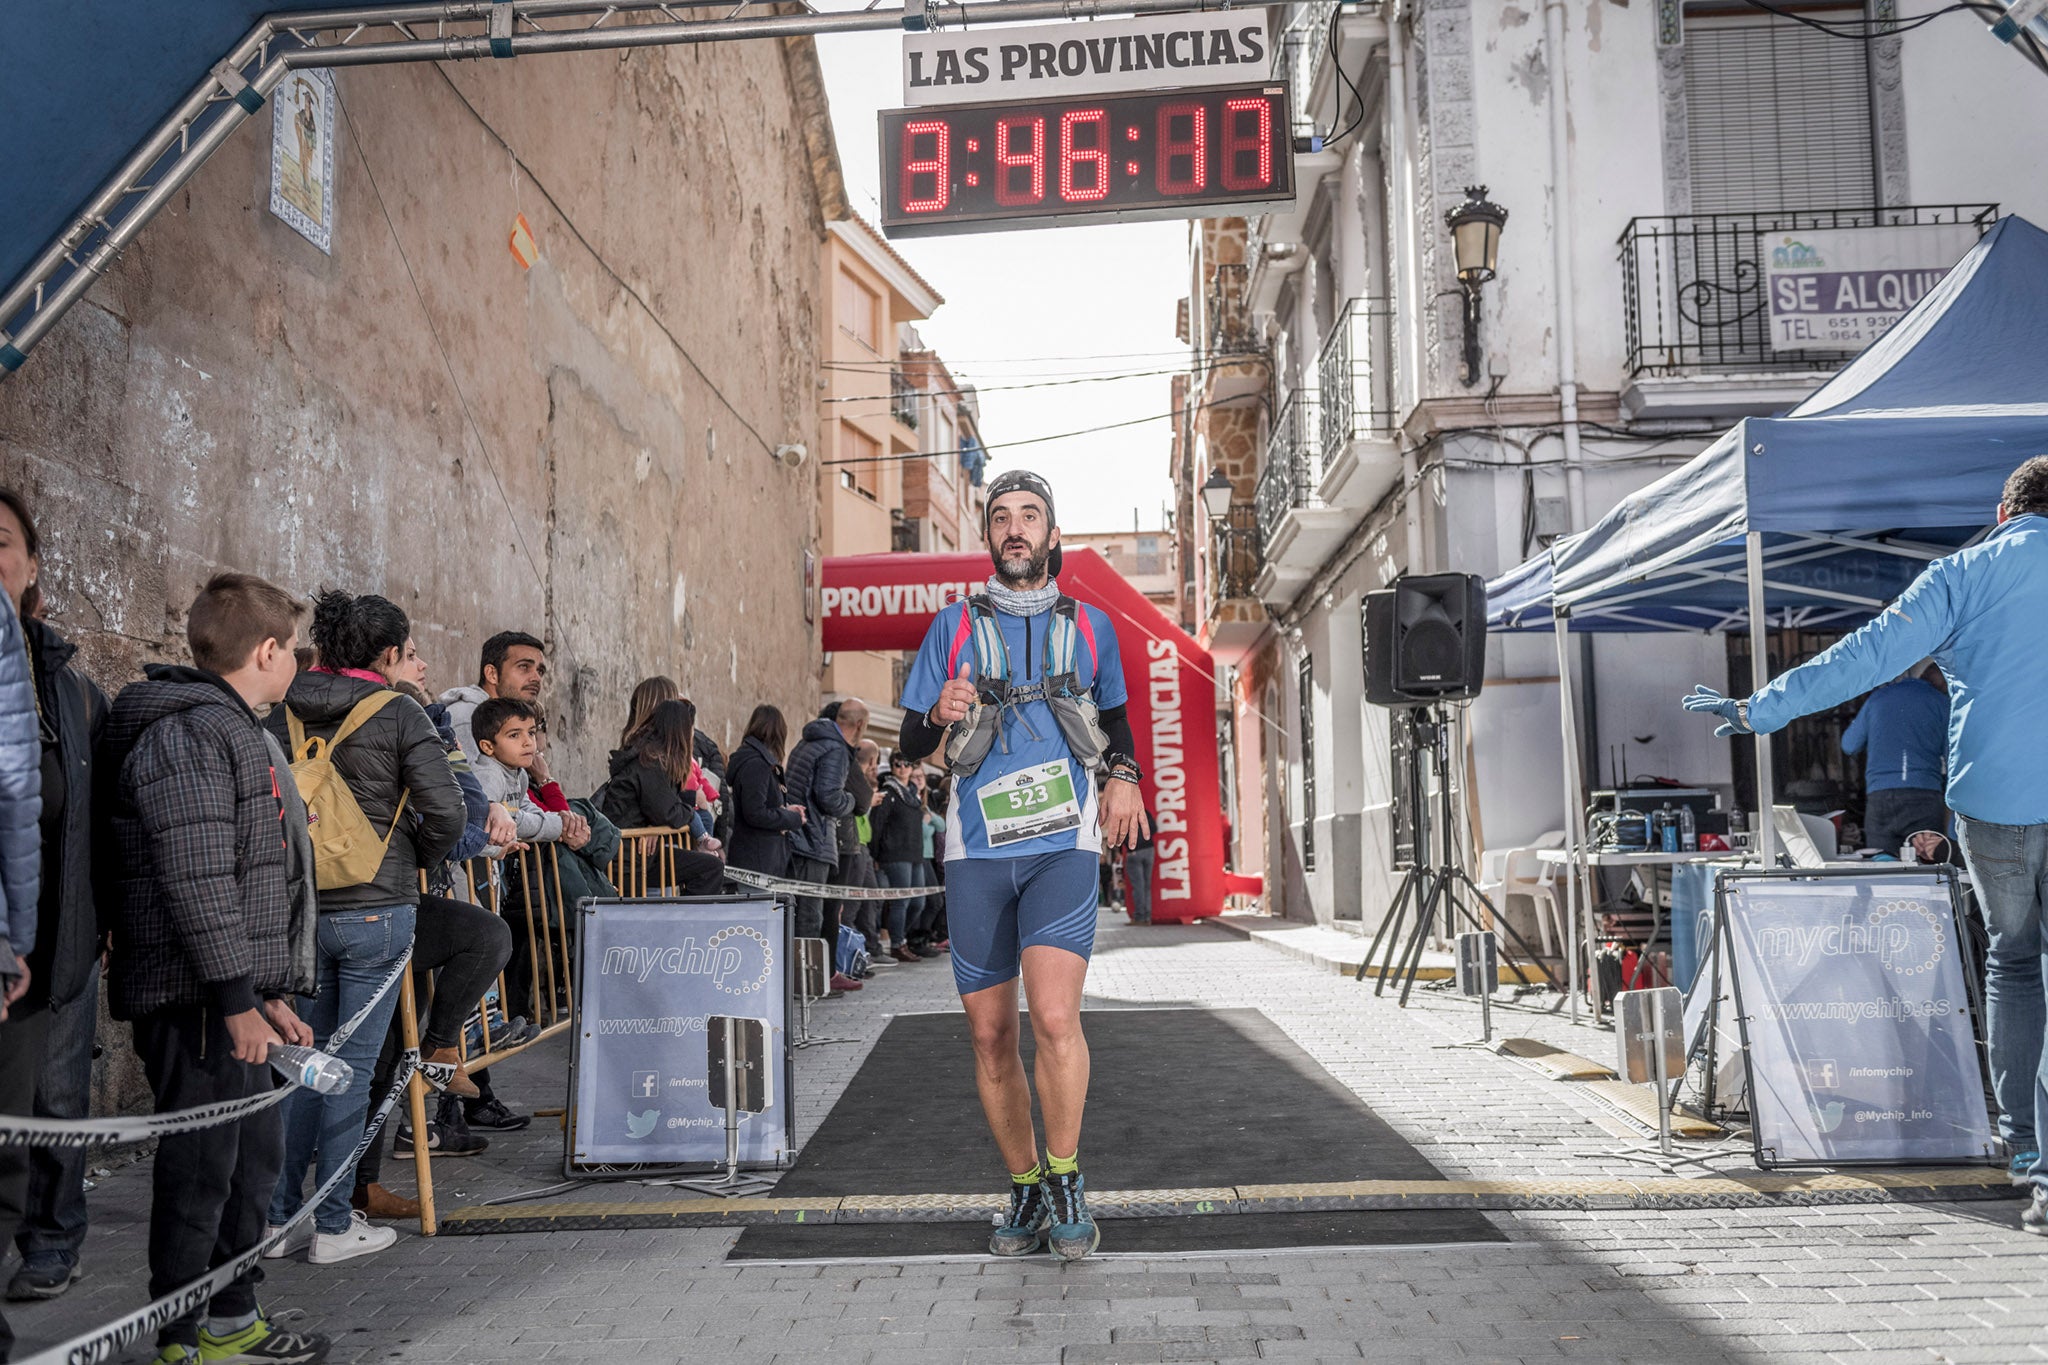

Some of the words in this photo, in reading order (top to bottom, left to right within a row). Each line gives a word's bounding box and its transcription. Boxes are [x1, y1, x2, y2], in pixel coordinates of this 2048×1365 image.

[908, 46, 989, 87] LAS
[1000, 26, 1264, 82] PROVINCIAS
[905, 98, 1271, 213] 3:46:17
[1777, 277, 1819, 311] SE
[1835, 272, 1942, 311] ALQUI
[1828, 317, 1859, 327] 651
[1830, 331, 1861, 340] 964
[1147, 638, 1188, 832] PROVINCIAS
[1008, 785, 1049, 810] 523
[1157, 837, 1192, 900] LAS
[601, 937, 742, 983] mychip
[1757, 914, 1909, 966] mychip
[1762, 997, 1950, 1024] www.mychip.es
[1849, 1066, 1914, 1078] /infomychip
